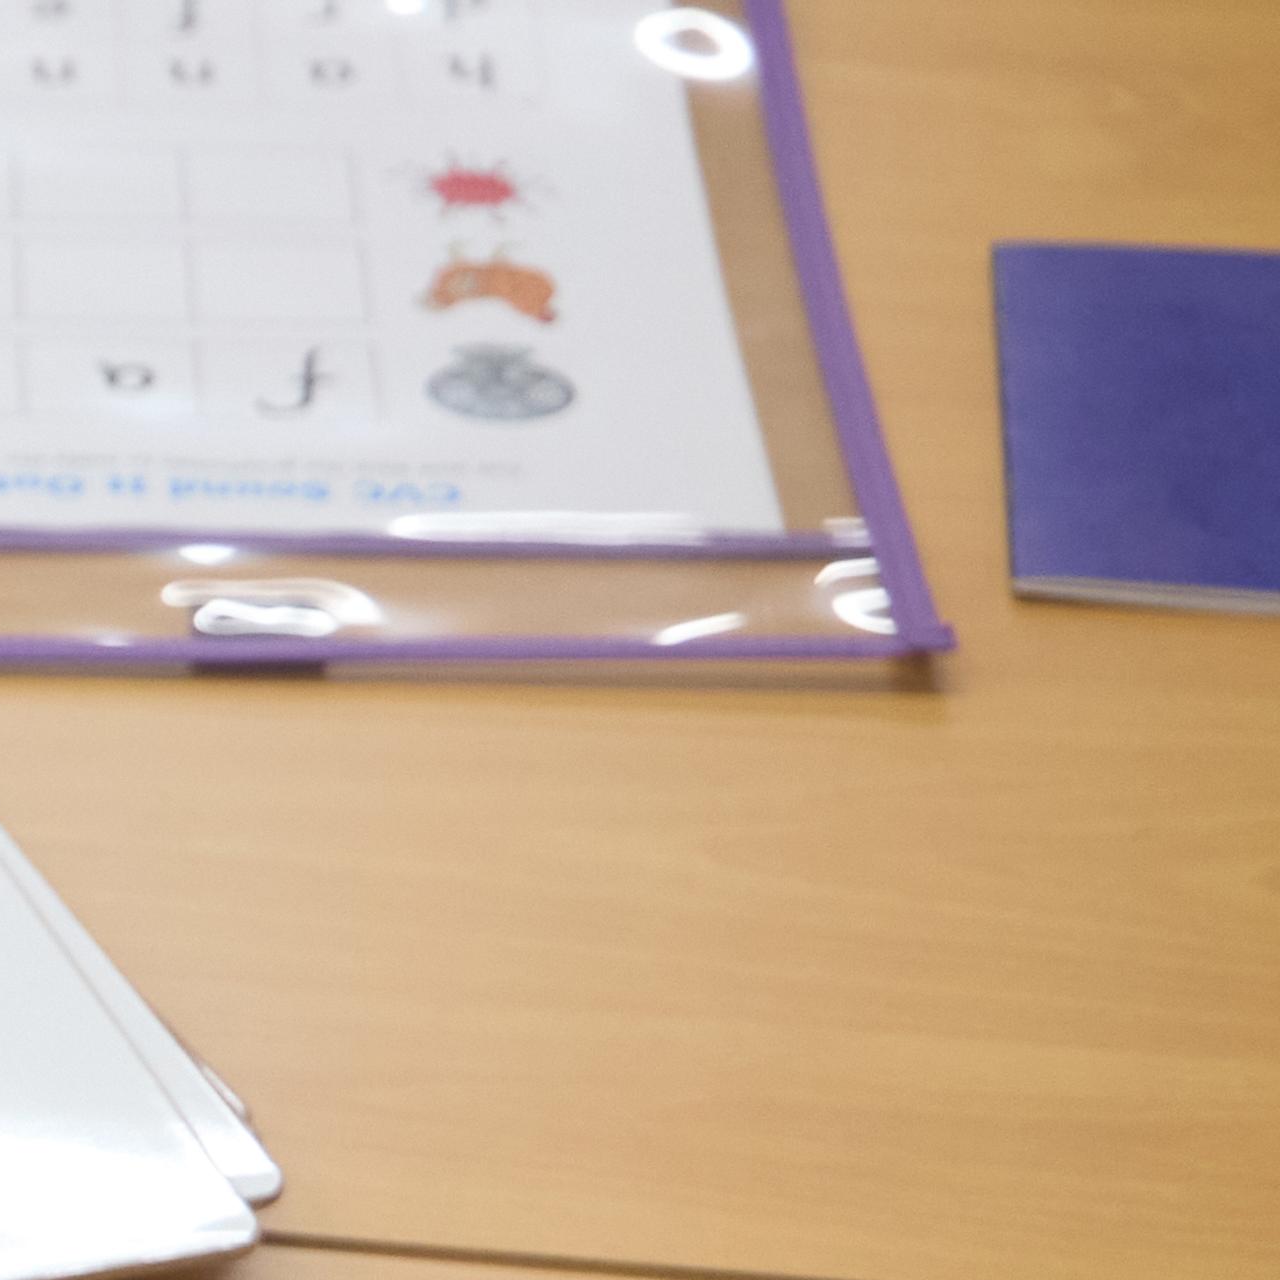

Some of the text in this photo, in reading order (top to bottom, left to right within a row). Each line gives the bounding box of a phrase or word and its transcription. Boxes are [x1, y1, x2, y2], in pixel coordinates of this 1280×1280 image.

[100, 358, 156, 392] a
[255, 345, 330, 420] f
[168, 475, 330, 502] Sound
[354, 478, 463, 504] CVC
